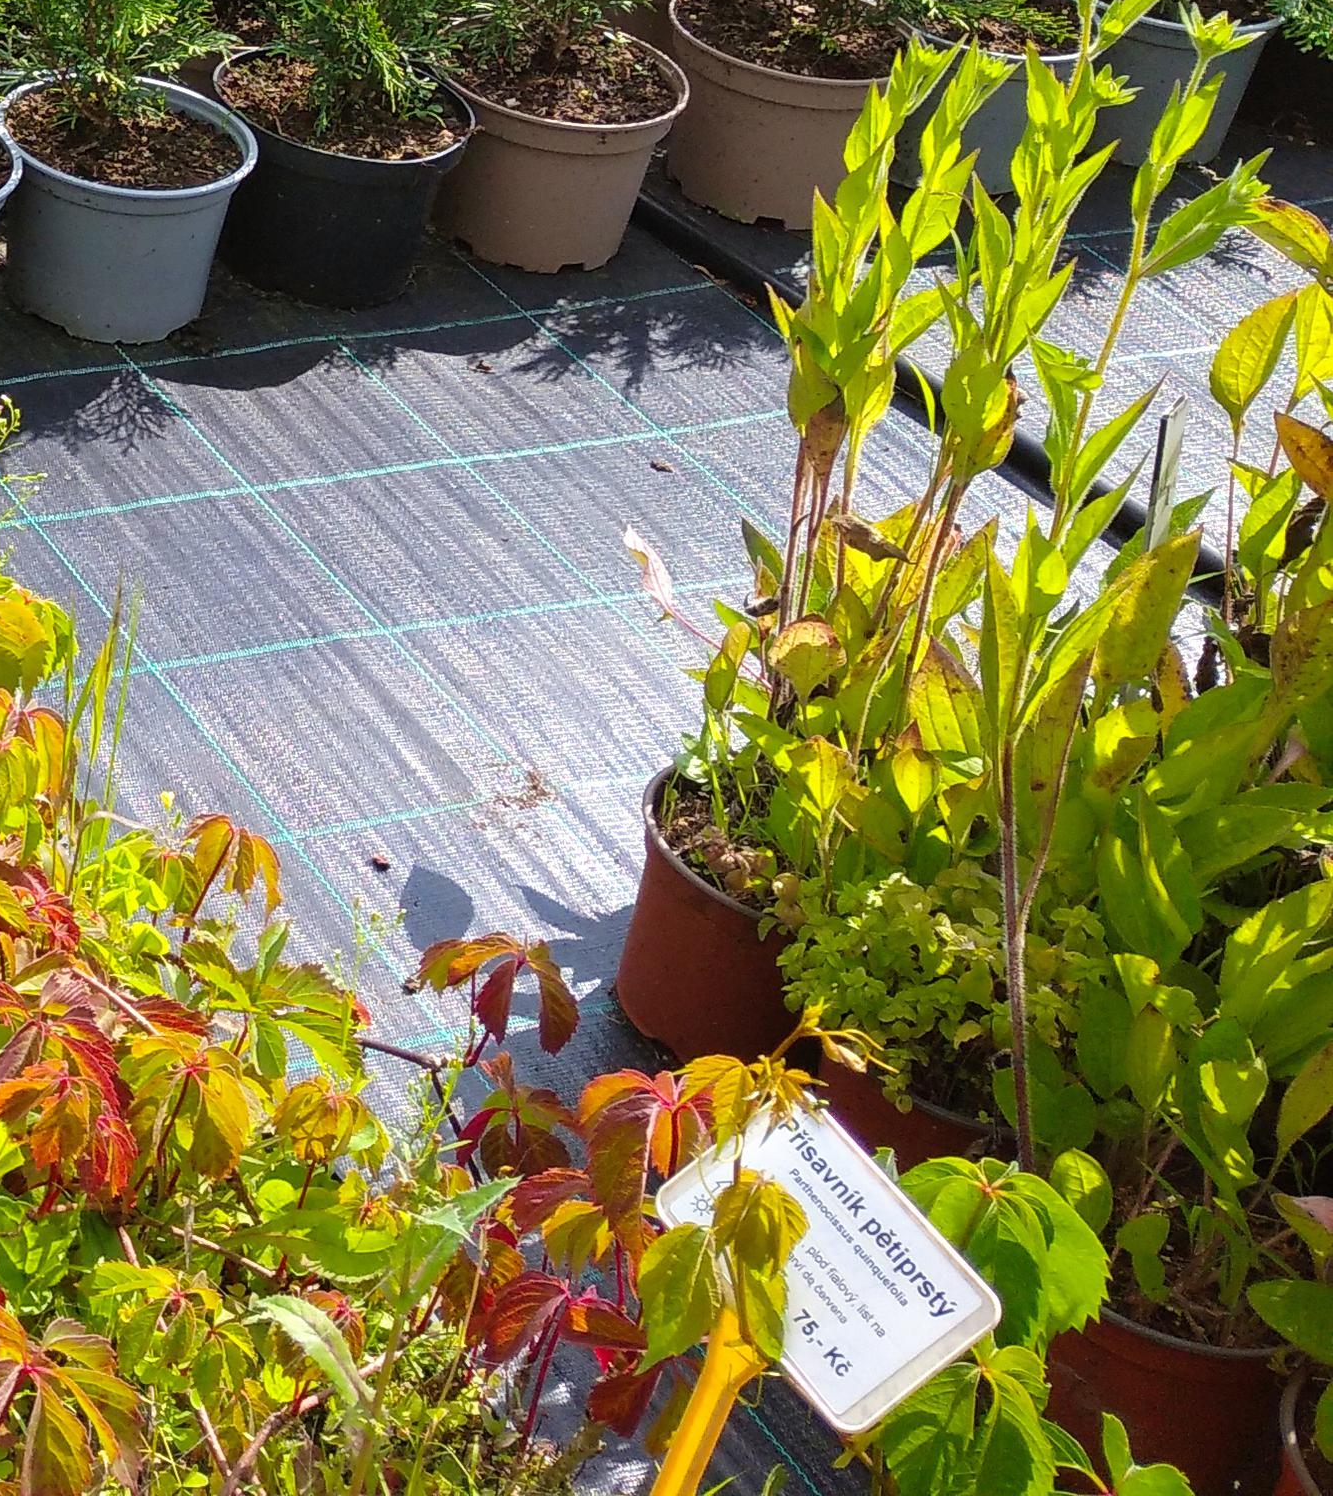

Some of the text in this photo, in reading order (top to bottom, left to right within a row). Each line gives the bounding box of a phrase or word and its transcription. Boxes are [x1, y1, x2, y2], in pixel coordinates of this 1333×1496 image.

[778, 1116, 958, 1317] Přísavník pětiprstý
[789, 1168, 909, 1307] Parthenocissus quinquefolia
[793, 1308, 853, 1377] 75,- Kč
[805, 1246, 831, 1269] plod
[856, 1304, 874, 1322] list
[870, 1322, 886, 1338] na
